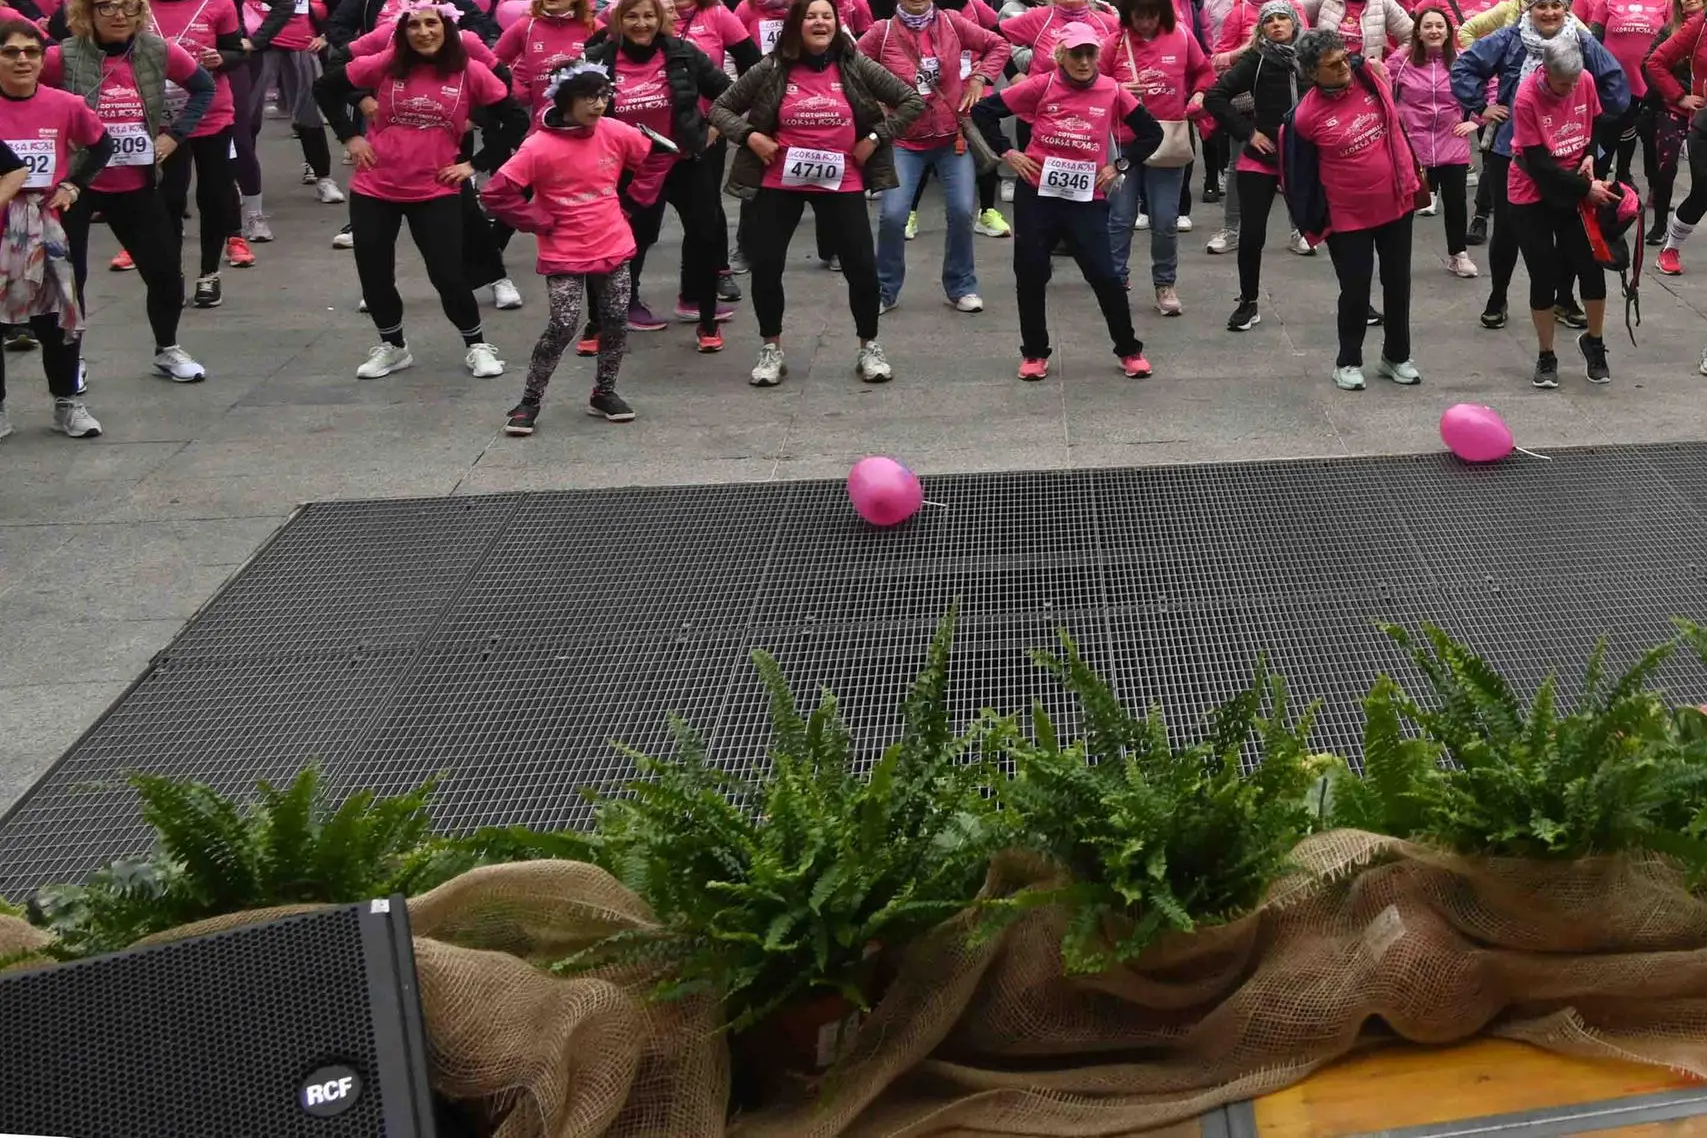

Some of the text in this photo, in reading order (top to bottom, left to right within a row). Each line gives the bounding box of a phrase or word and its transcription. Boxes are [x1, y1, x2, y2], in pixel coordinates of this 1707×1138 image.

[614, 103, 644, 112] CORSA
[1045, 137, 1070, 147] CORSA
[794, 150, 821, 160] CORSA
[24, 155, 49, 173] 92
[791, 162, 837, 179] 4710
[1051, 159, 1076, 170] CORSA
[1047, 170, 1089, 190] 6346
[306, 1076, 353, 1106] RCF
